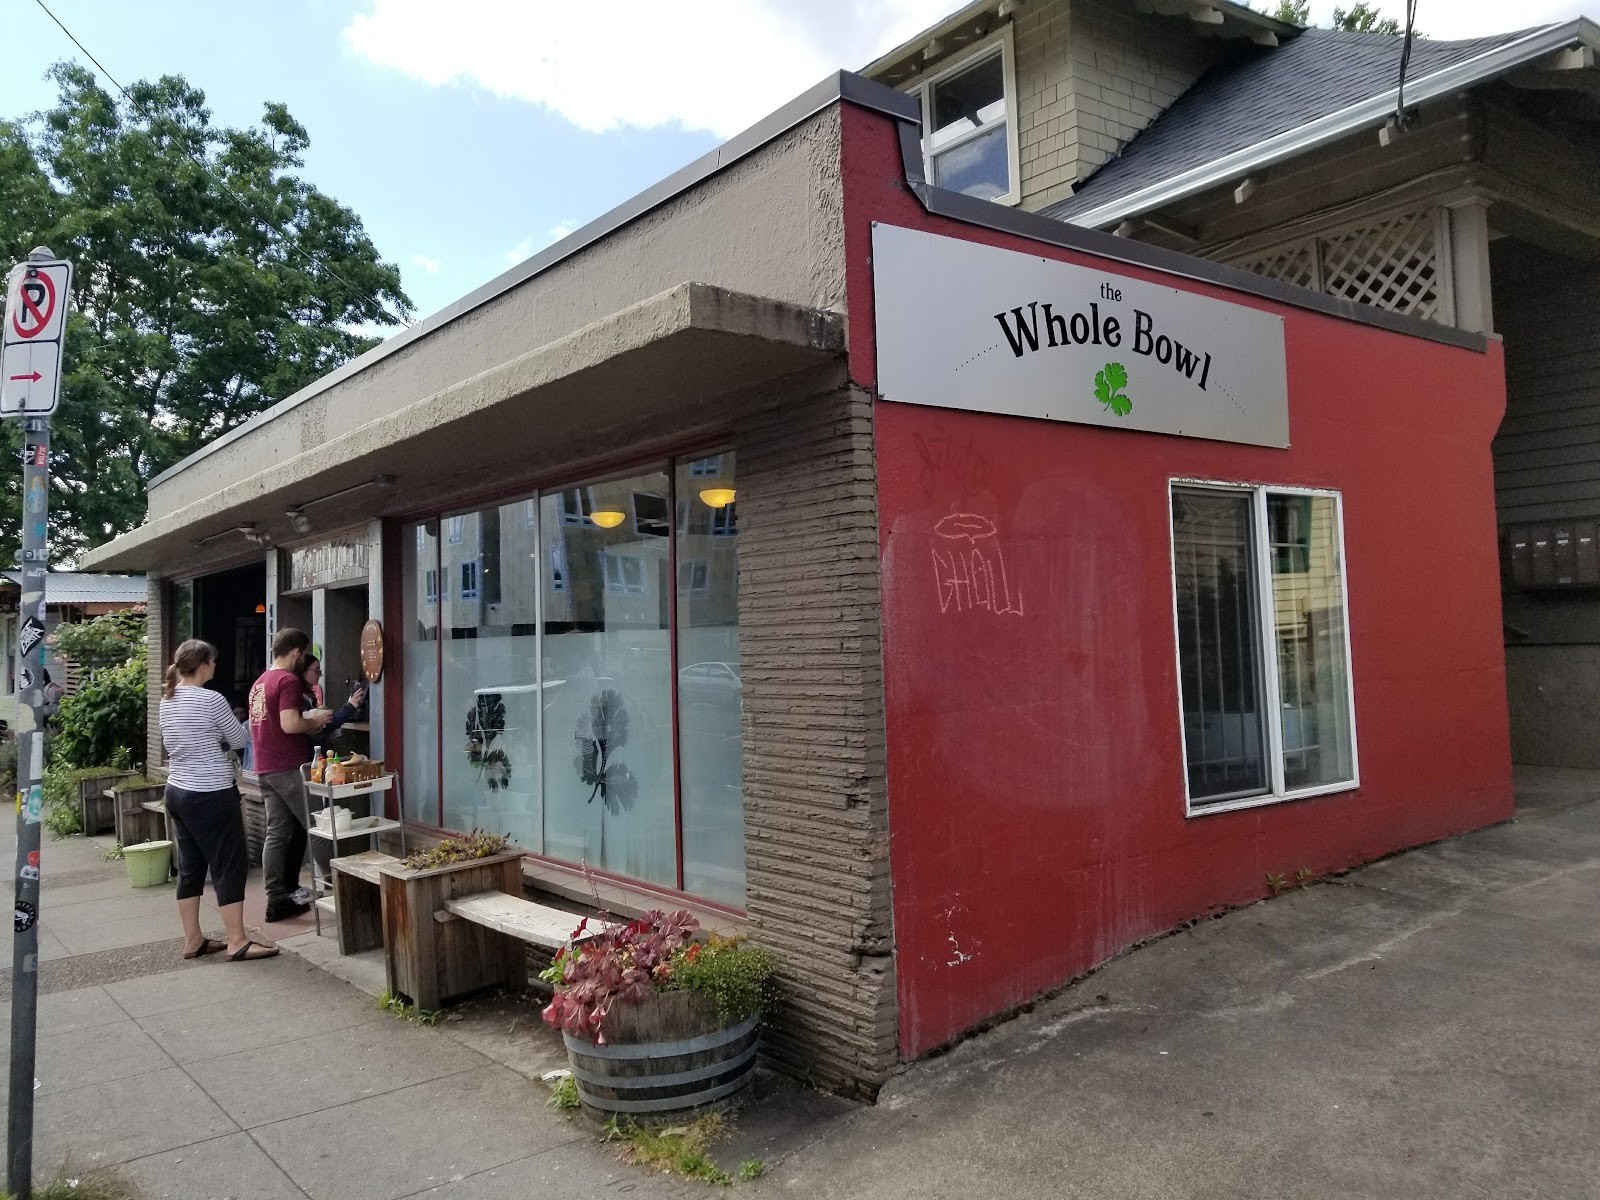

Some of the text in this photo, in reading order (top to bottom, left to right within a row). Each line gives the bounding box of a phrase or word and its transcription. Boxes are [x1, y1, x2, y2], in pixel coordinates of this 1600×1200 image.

[1100, 283, 1122, 301] the
[995, 302, 1212, 391] Whole Bowl
